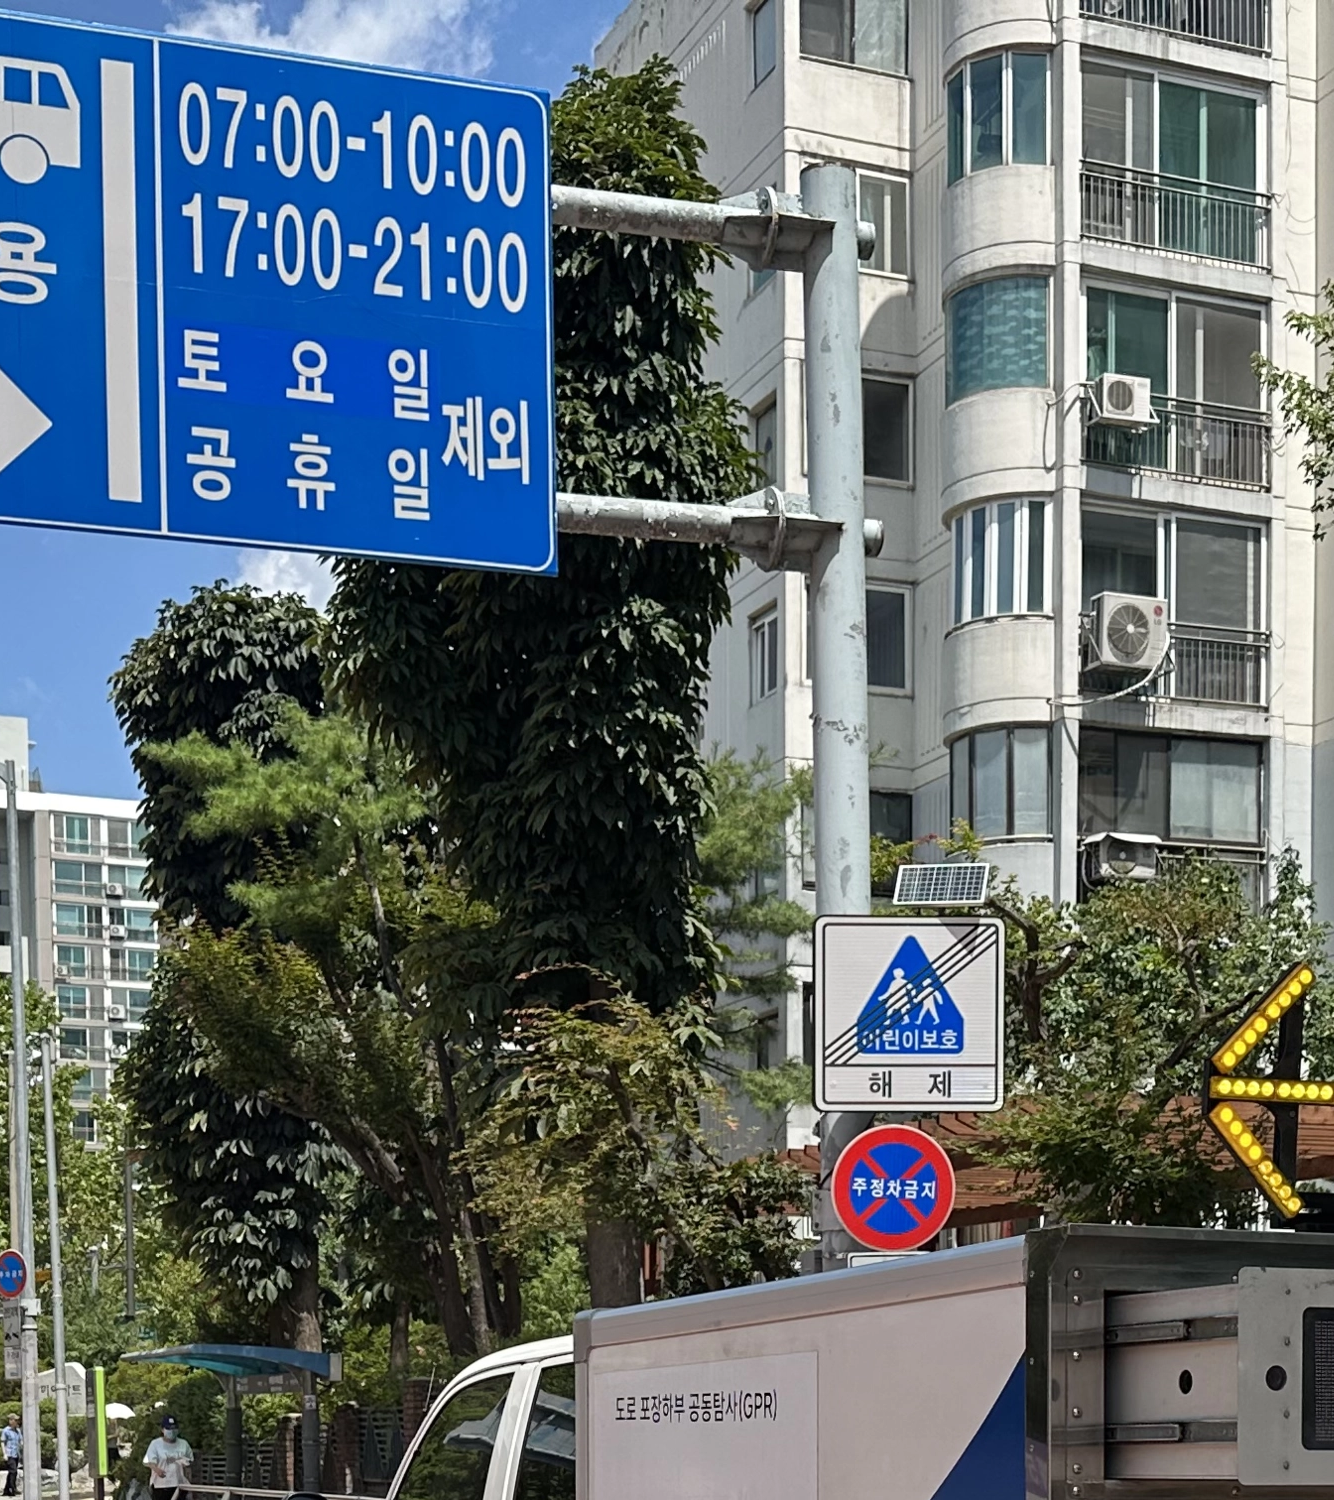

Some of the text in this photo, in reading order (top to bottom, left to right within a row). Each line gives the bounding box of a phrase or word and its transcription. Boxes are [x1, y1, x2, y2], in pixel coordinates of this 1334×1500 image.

[178, 81, 527, 208] 07:00-10:00
[180, 192, 529, 313] 17:00-21:00
[441, 396, 530, 486] 제외
[861, 1028, 960, 1052] 어린이보호
[851, 1176, 938, 1200] 주정차금지
[615, 1388, 778, 1424] 도로 포장하부 공동탐사(GPR)
